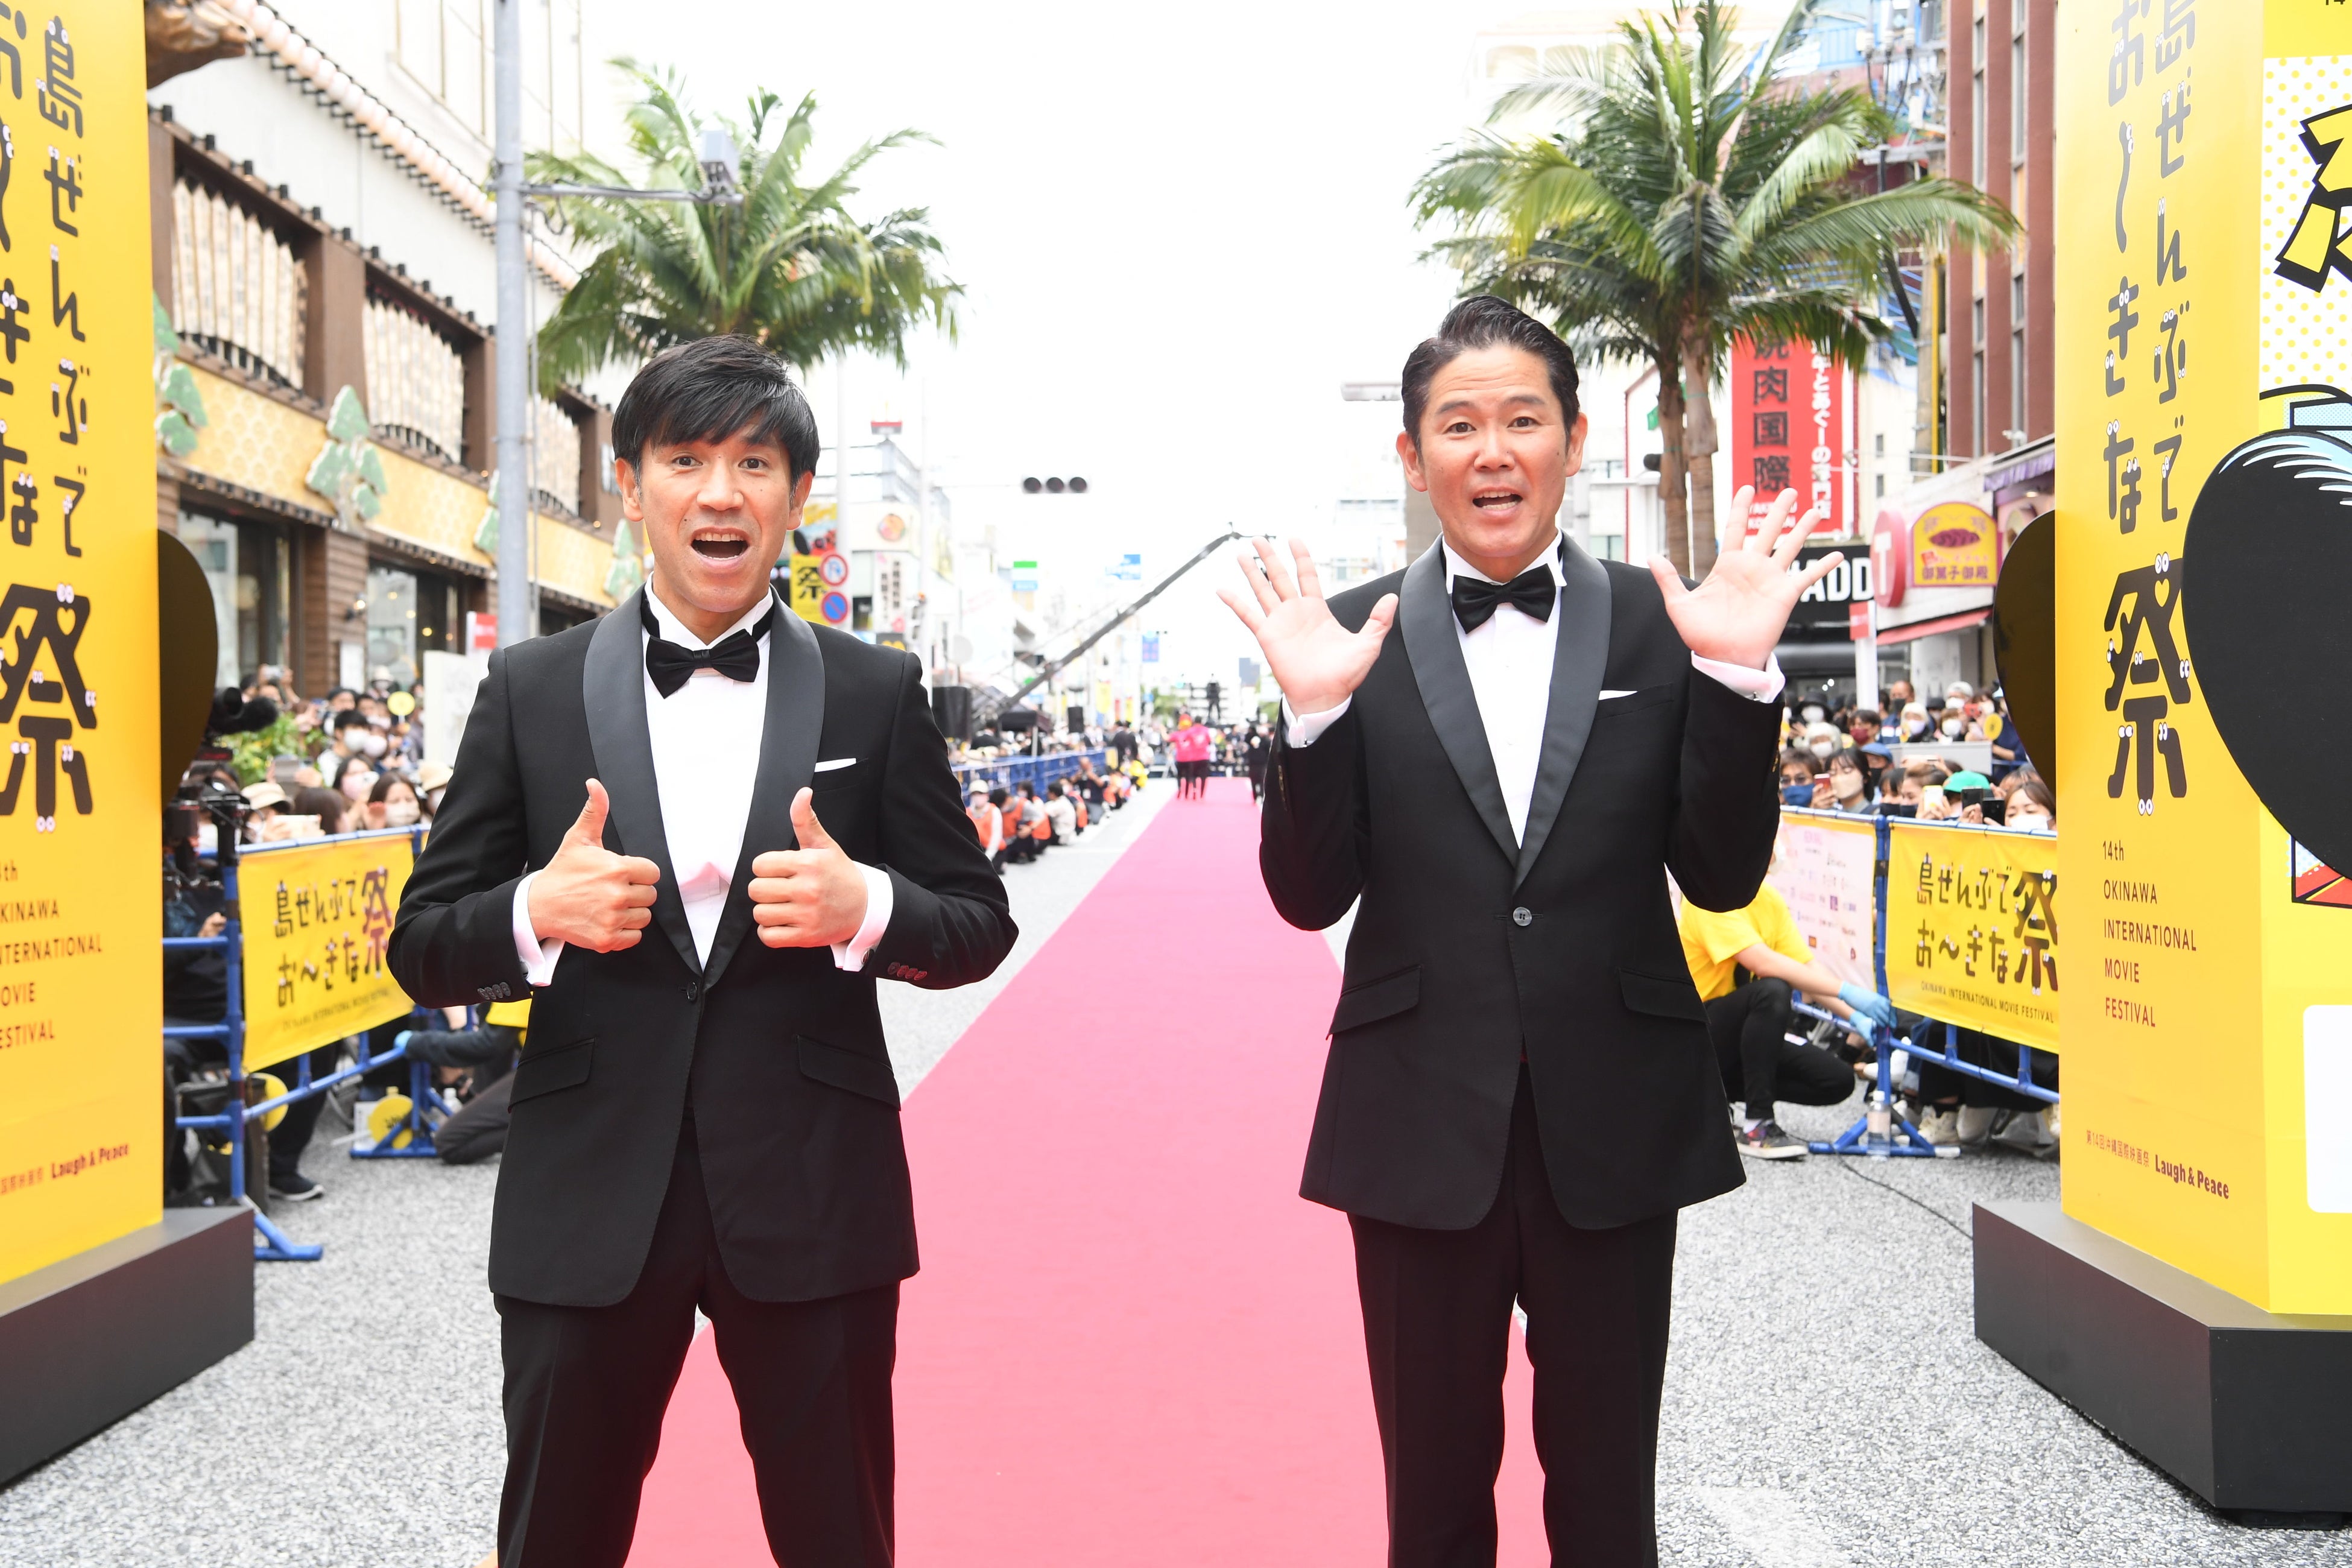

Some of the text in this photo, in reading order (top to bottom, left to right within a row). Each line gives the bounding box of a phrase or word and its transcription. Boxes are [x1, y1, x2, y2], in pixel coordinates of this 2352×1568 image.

[2102, 840, 2124, 862] 14th
[0, 859, 17, 881] th
[1917, 852, 2011, 914] 島ぜんぶで
[2104, 879, 2158, 905] OKINAWA
[2104, 918, 2197, 952] INTERNATIONAL
[2105, 958, 2140, 984] MOVIE
[1949, 988, 1997, 1010] INTERNATIONAL
[2000, 1001, 2019, 1016] MOVIE
[2022, 1005, 2054, 1024] FESTIVAL
[2105, 997, 2156, 1028] FESTIVAL
[2155, 1154, 2186, 1184] Laugh
[2188, 1166, 2195, 1187] &
[2197, 1169, 2230, 1200] Peace
